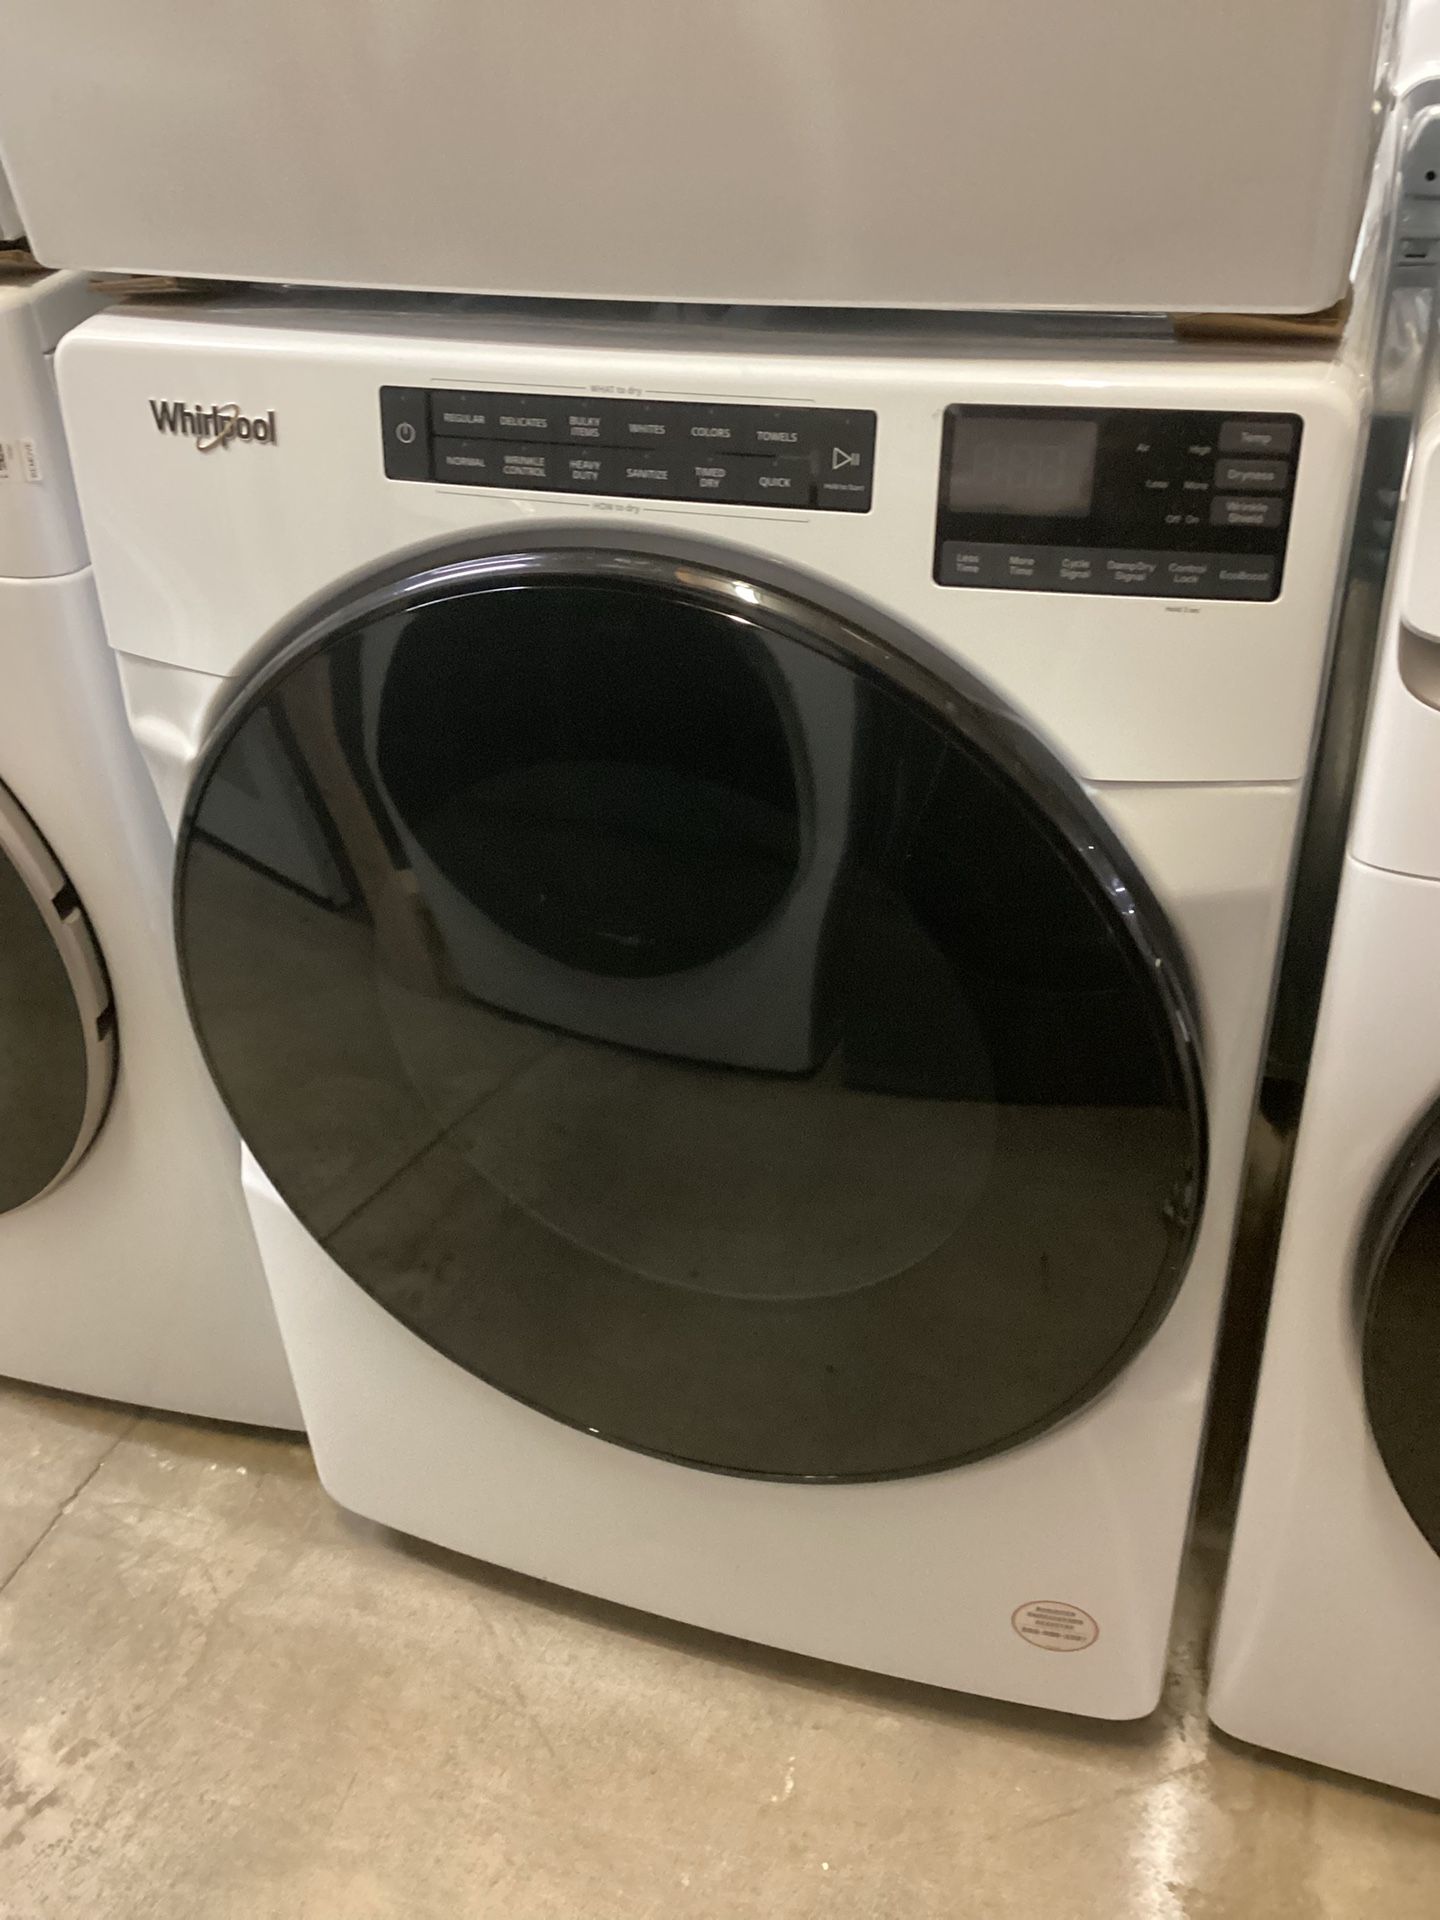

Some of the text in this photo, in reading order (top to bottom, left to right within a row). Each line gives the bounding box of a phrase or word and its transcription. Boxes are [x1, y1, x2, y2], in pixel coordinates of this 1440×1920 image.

[149, 399, 279, 450] Whirlpool
[443, 412, 486, 425] REGULAR
[500, 415, 548, 429] DELICATES
[568, 415, 601, 427] BULKY
[570, 426, 600, 438] ITEMS
[628, 423, 666, 435] WHITES
[690, 426, 731, 439] COLORS
[756, 430, 798, 443] TOWELS
[446, 455, 486, 467] NORMAL
[504, 455, 546, 466] WRINKLE
[568, 459, 601, 470] HEAVY
[503, 465, 547, 477] CONTROL
[572, 469, 599, 480] DUTY
[626, 467, 668, 481] SANITIZE
[695, 466, 727, 478] TIMED
[699, 477, 721, 489] DRY
[758, 476, 792, 488] QUICK
